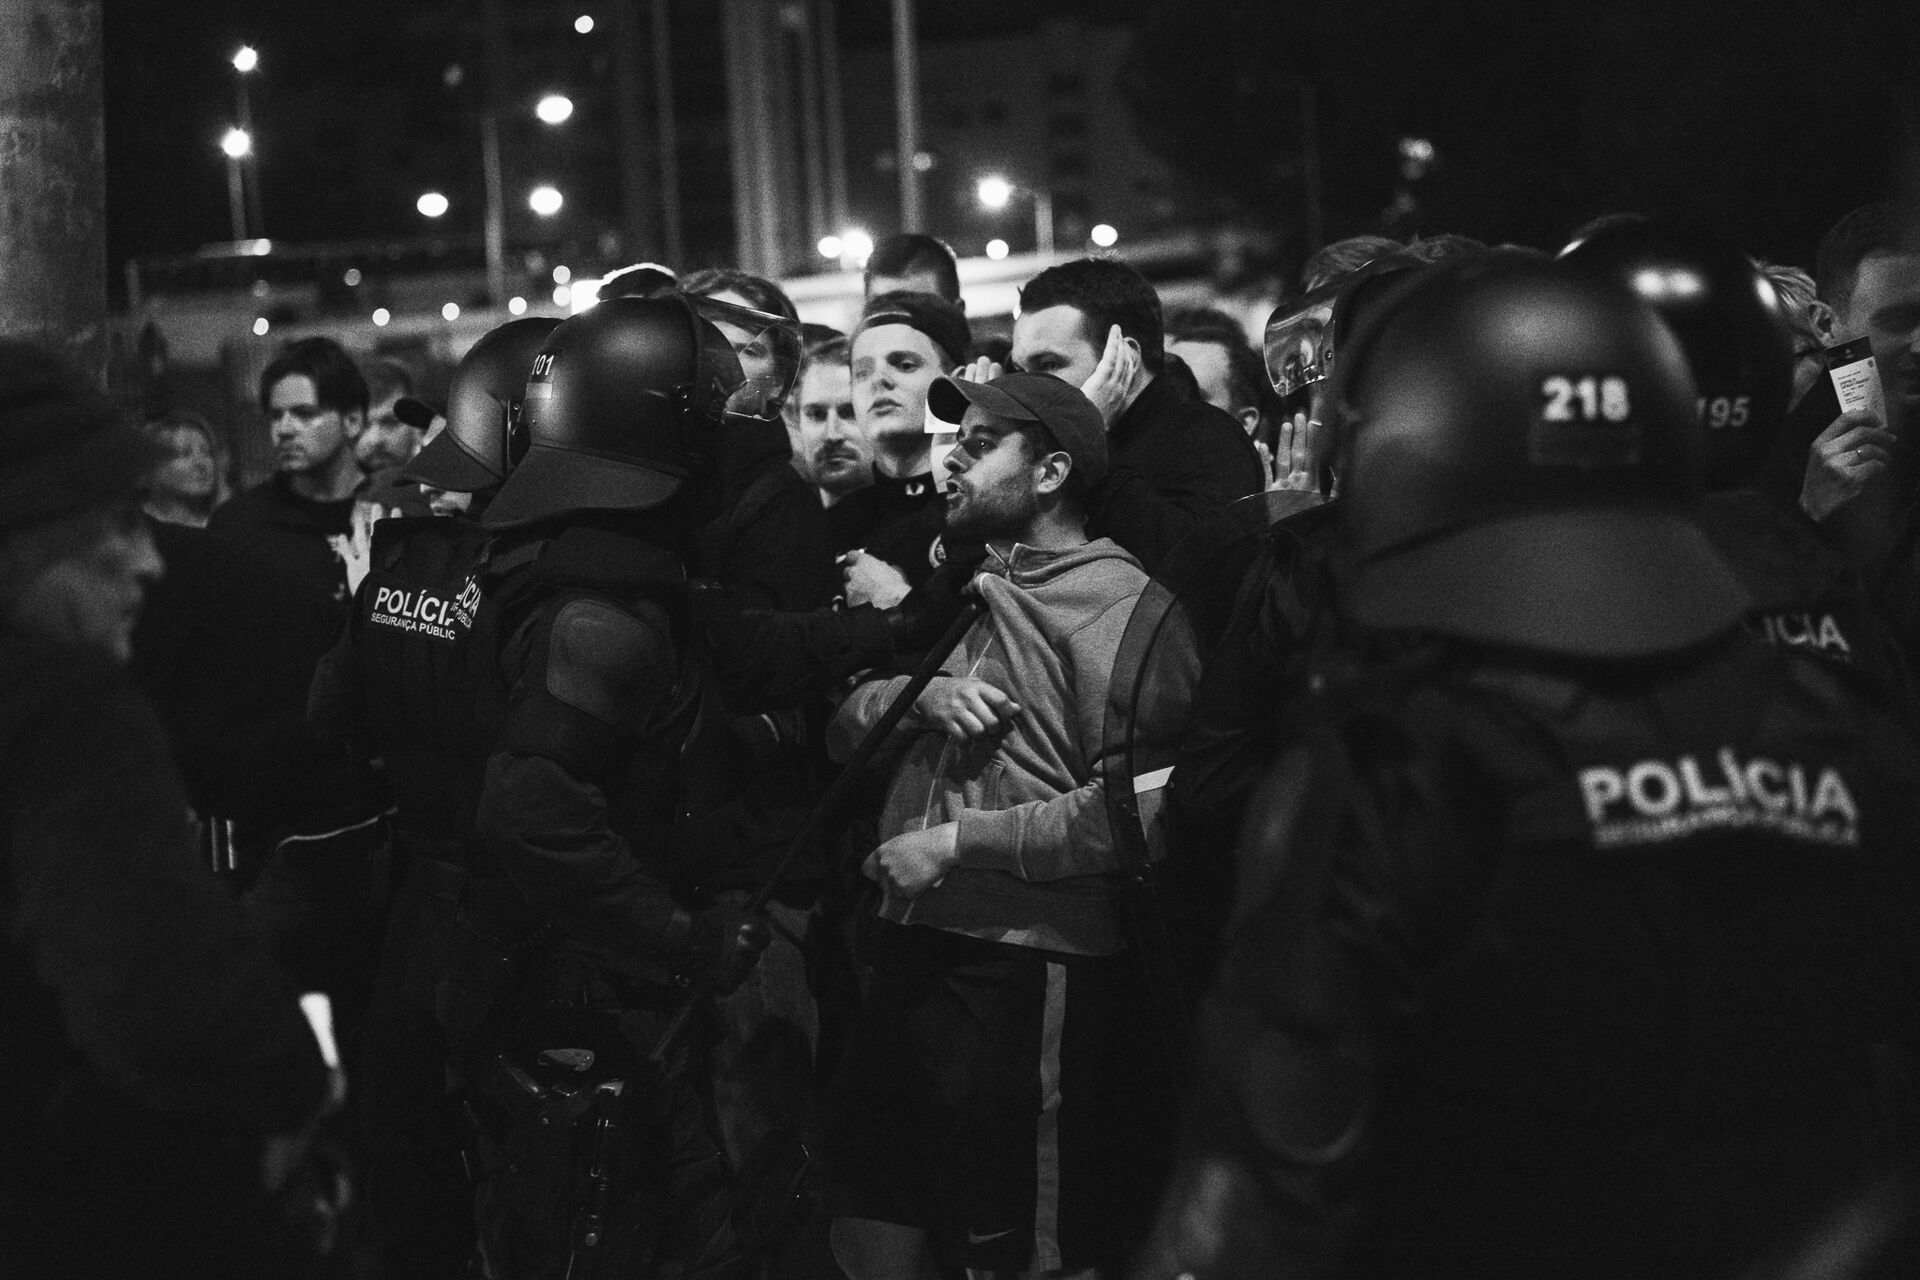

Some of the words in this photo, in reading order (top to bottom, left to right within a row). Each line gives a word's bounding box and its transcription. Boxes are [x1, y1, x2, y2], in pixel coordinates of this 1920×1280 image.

[531, 354, 555, 376] 101
[1540, 375, 1631, 423] 218
[370, 612, 417, 632] SEGURANÇA
[419, 622, 456, 640] PÚBLIC
